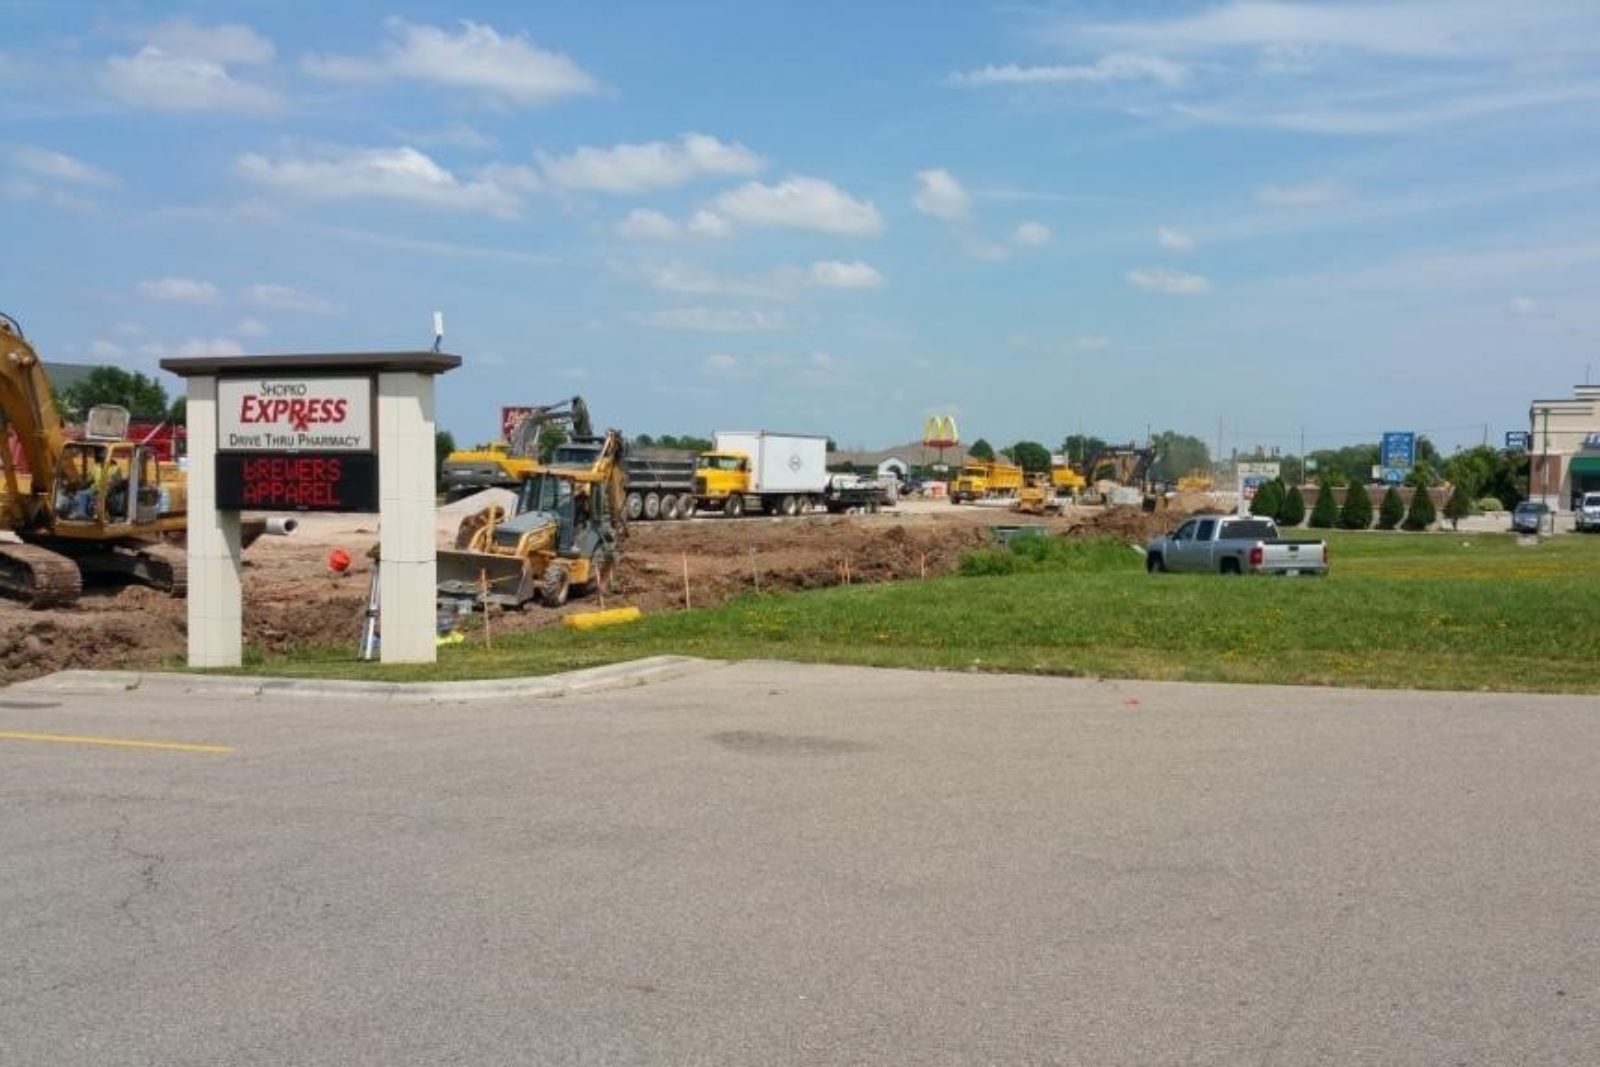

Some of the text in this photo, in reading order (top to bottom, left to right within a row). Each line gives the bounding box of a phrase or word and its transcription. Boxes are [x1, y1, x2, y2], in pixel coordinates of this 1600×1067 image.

[260, 381, 307, 396] SHOPKO
[240, 395, 347, 431] EXPRESS
[229, 433, 361, 447] DRIVE THRU PHARMACY
[244, 459, 342, 481] BREWERS
[243, 482, 341, 504] APPAREL
